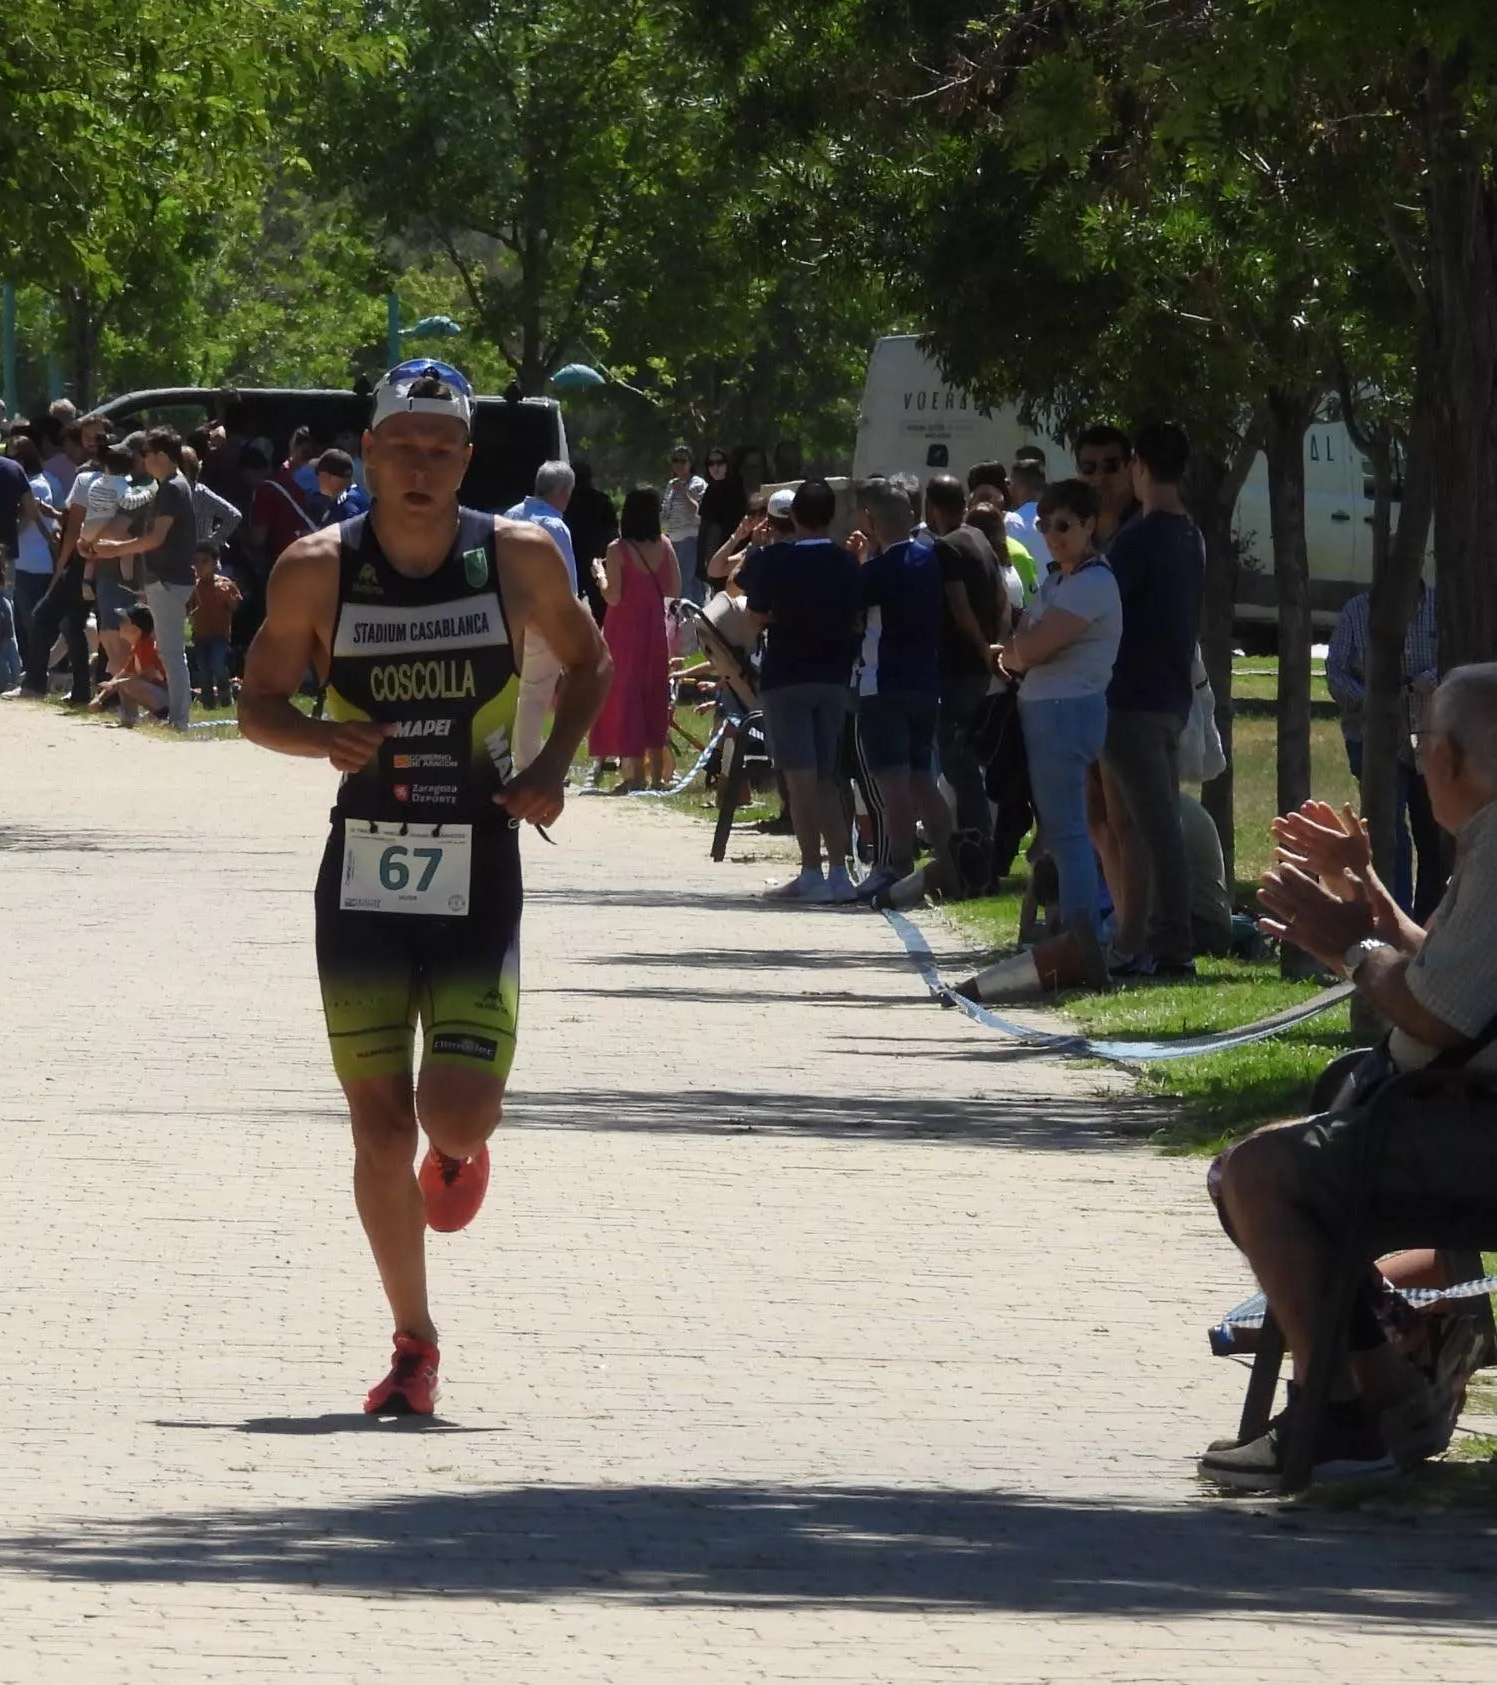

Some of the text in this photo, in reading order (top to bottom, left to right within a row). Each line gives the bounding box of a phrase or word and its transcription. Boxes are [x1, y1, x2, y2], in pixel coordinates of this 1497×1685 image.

[353, 612, 490, 644] STADIUM CASABLANCA
[370, 659, 476, 701] COSCOLLA
[394, 719, 452, 738] MAPEI
[379, 845, 443, 891] 67
